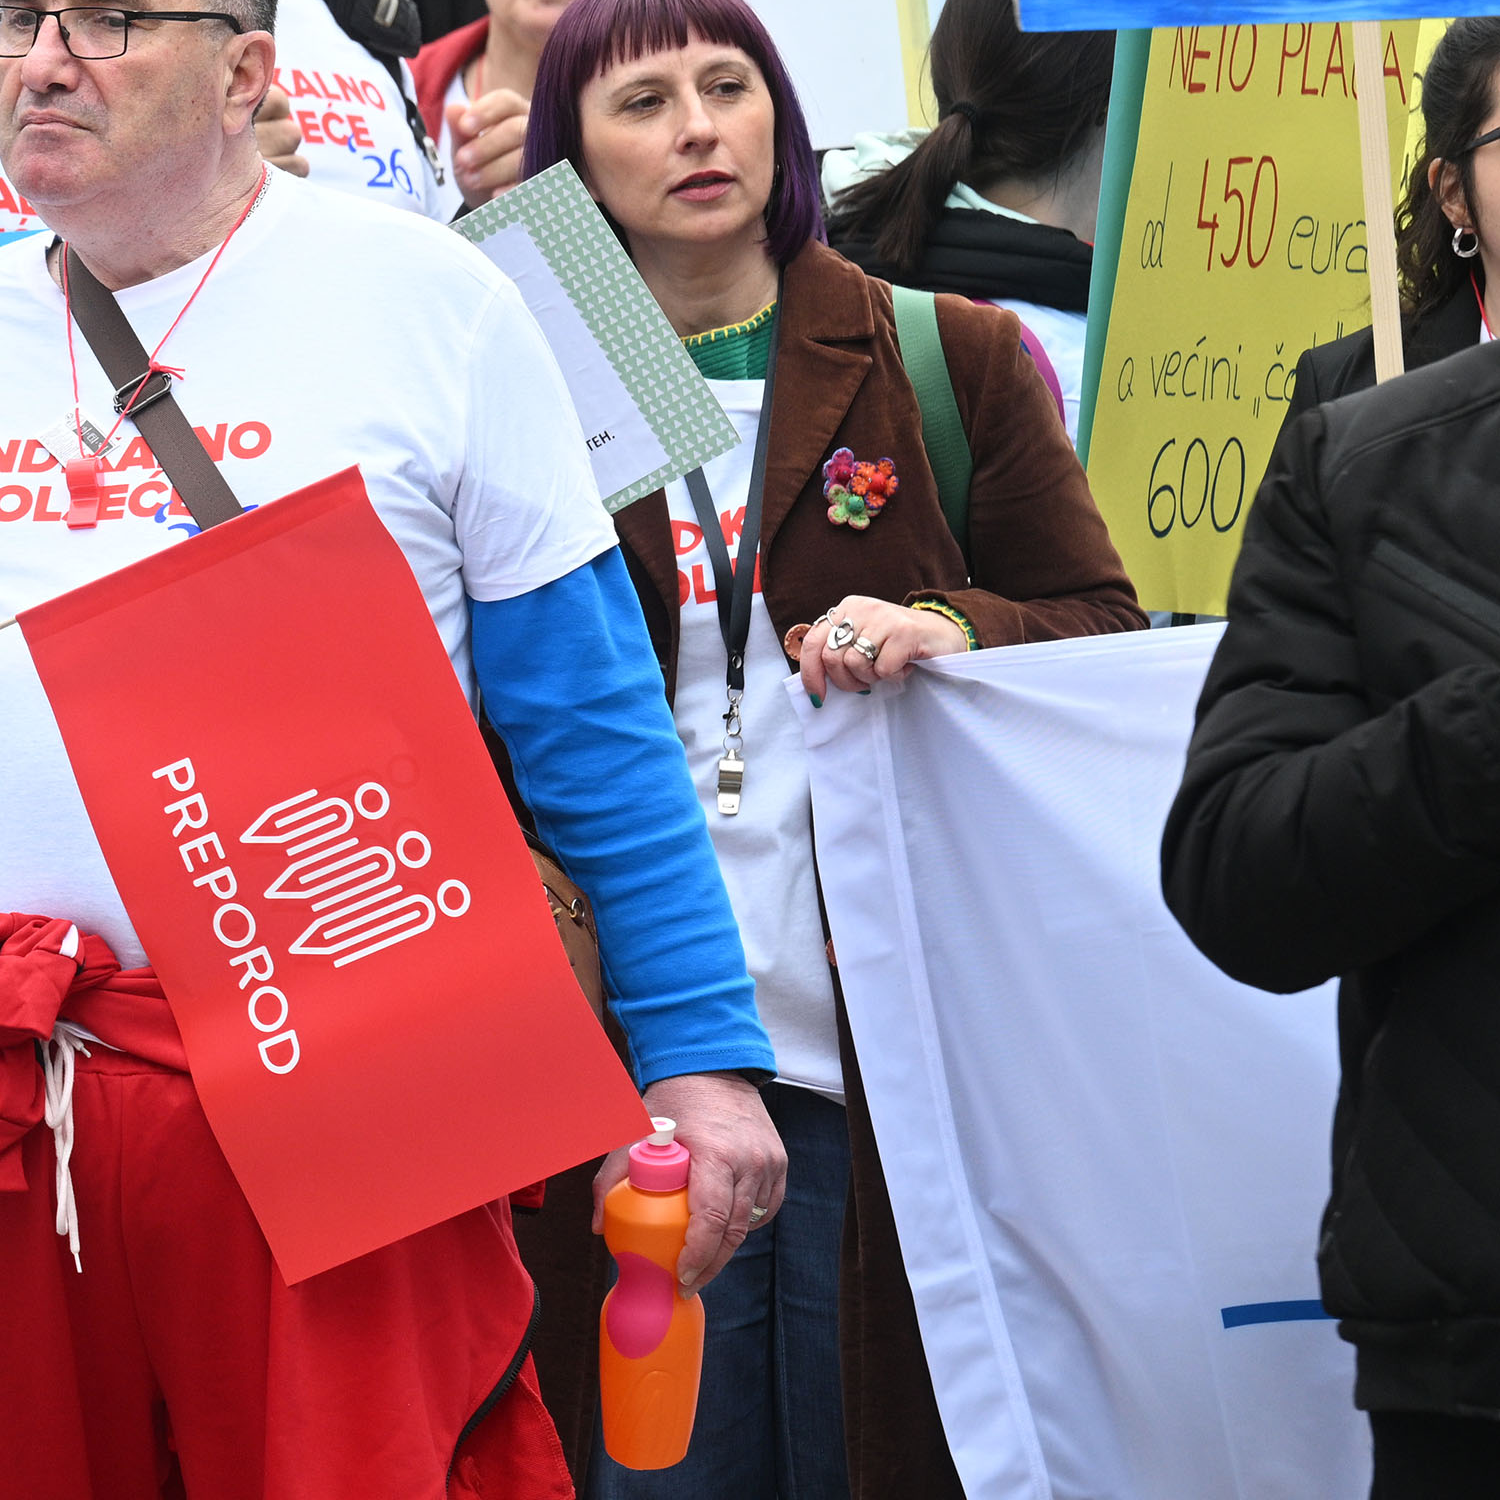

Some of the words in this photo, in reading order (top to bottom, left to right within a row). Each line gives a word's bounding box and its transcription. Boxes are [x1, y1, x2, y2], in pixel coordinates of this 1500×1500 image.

[1196, 155, 1280, 272] 450
[1147, 437, 1247, 540] 600
[150, 756, 302, 1076] PREPOROD
